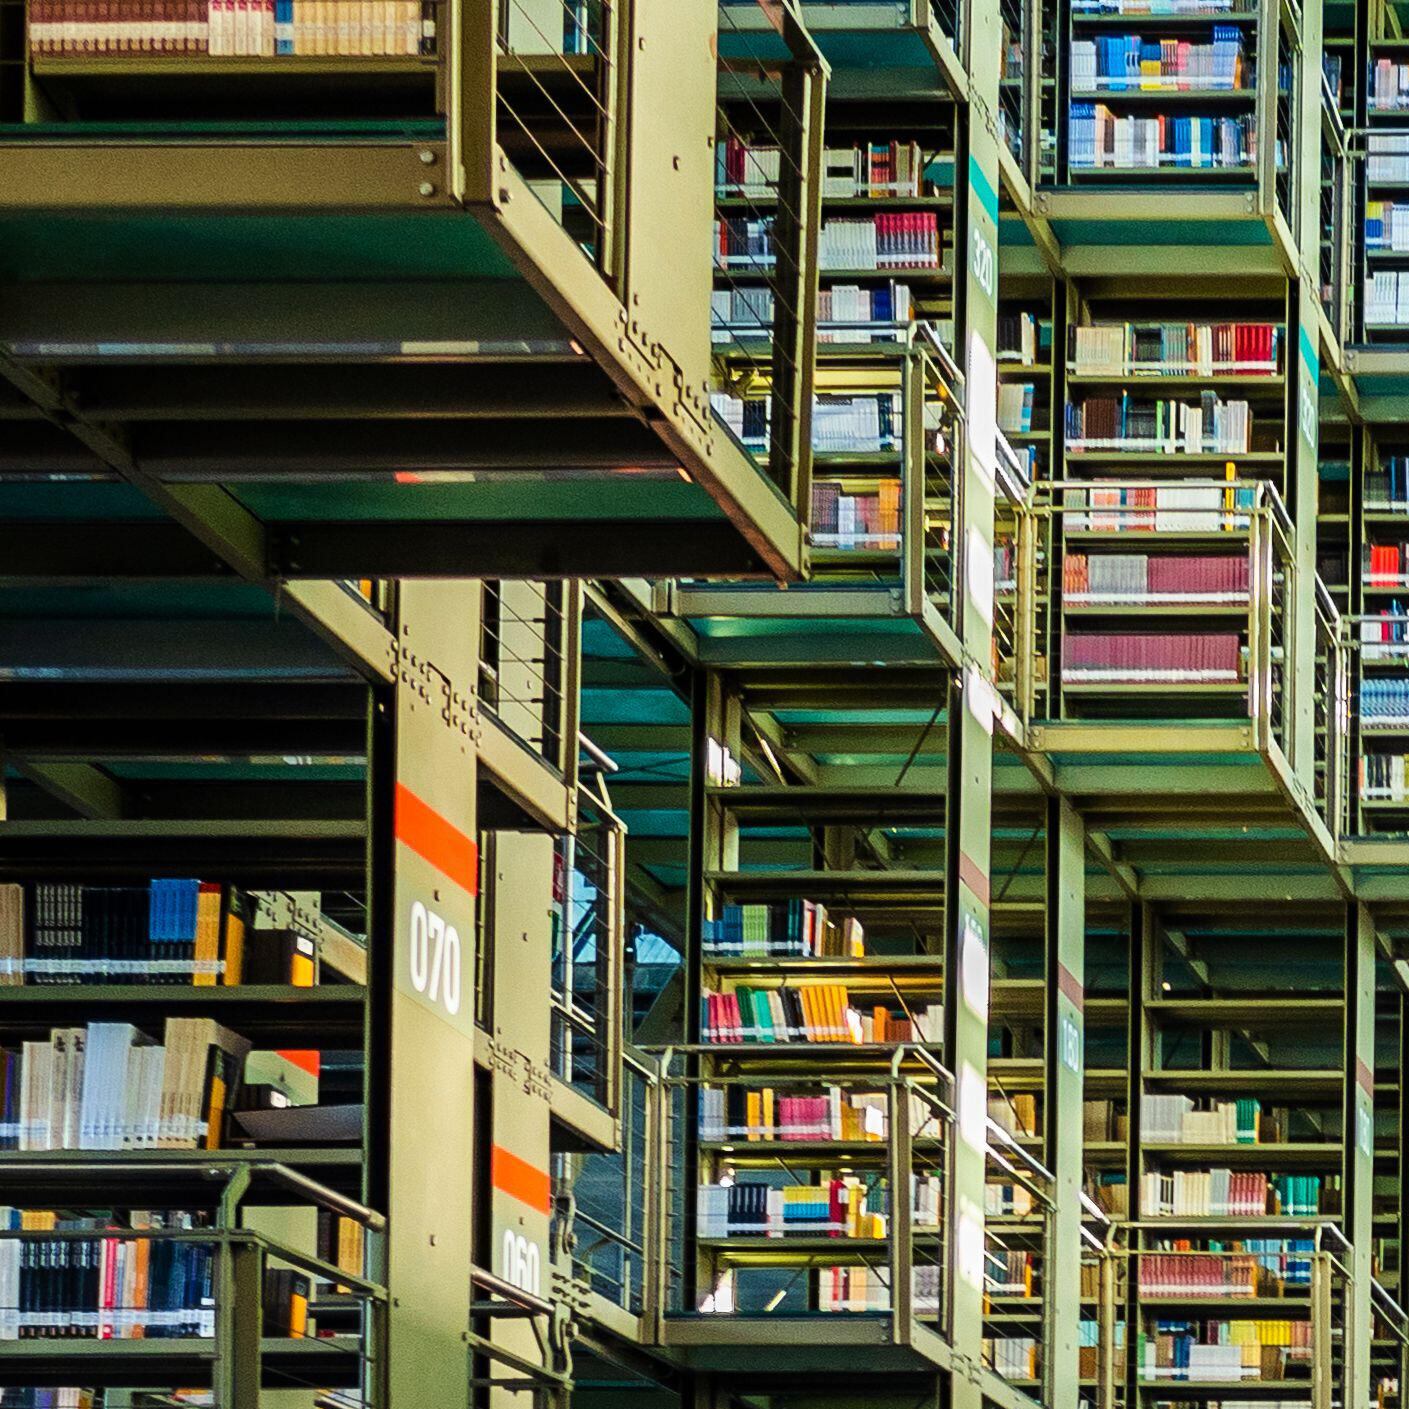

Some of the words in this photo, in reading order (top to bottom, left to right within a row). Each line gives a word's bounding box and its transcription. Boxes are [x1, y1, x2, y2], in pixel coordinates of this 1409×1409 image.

[973, 227, 993, 297] 320
[410, 900, 461, 1015] 070
[503, 1229, 540, 1298] 060
